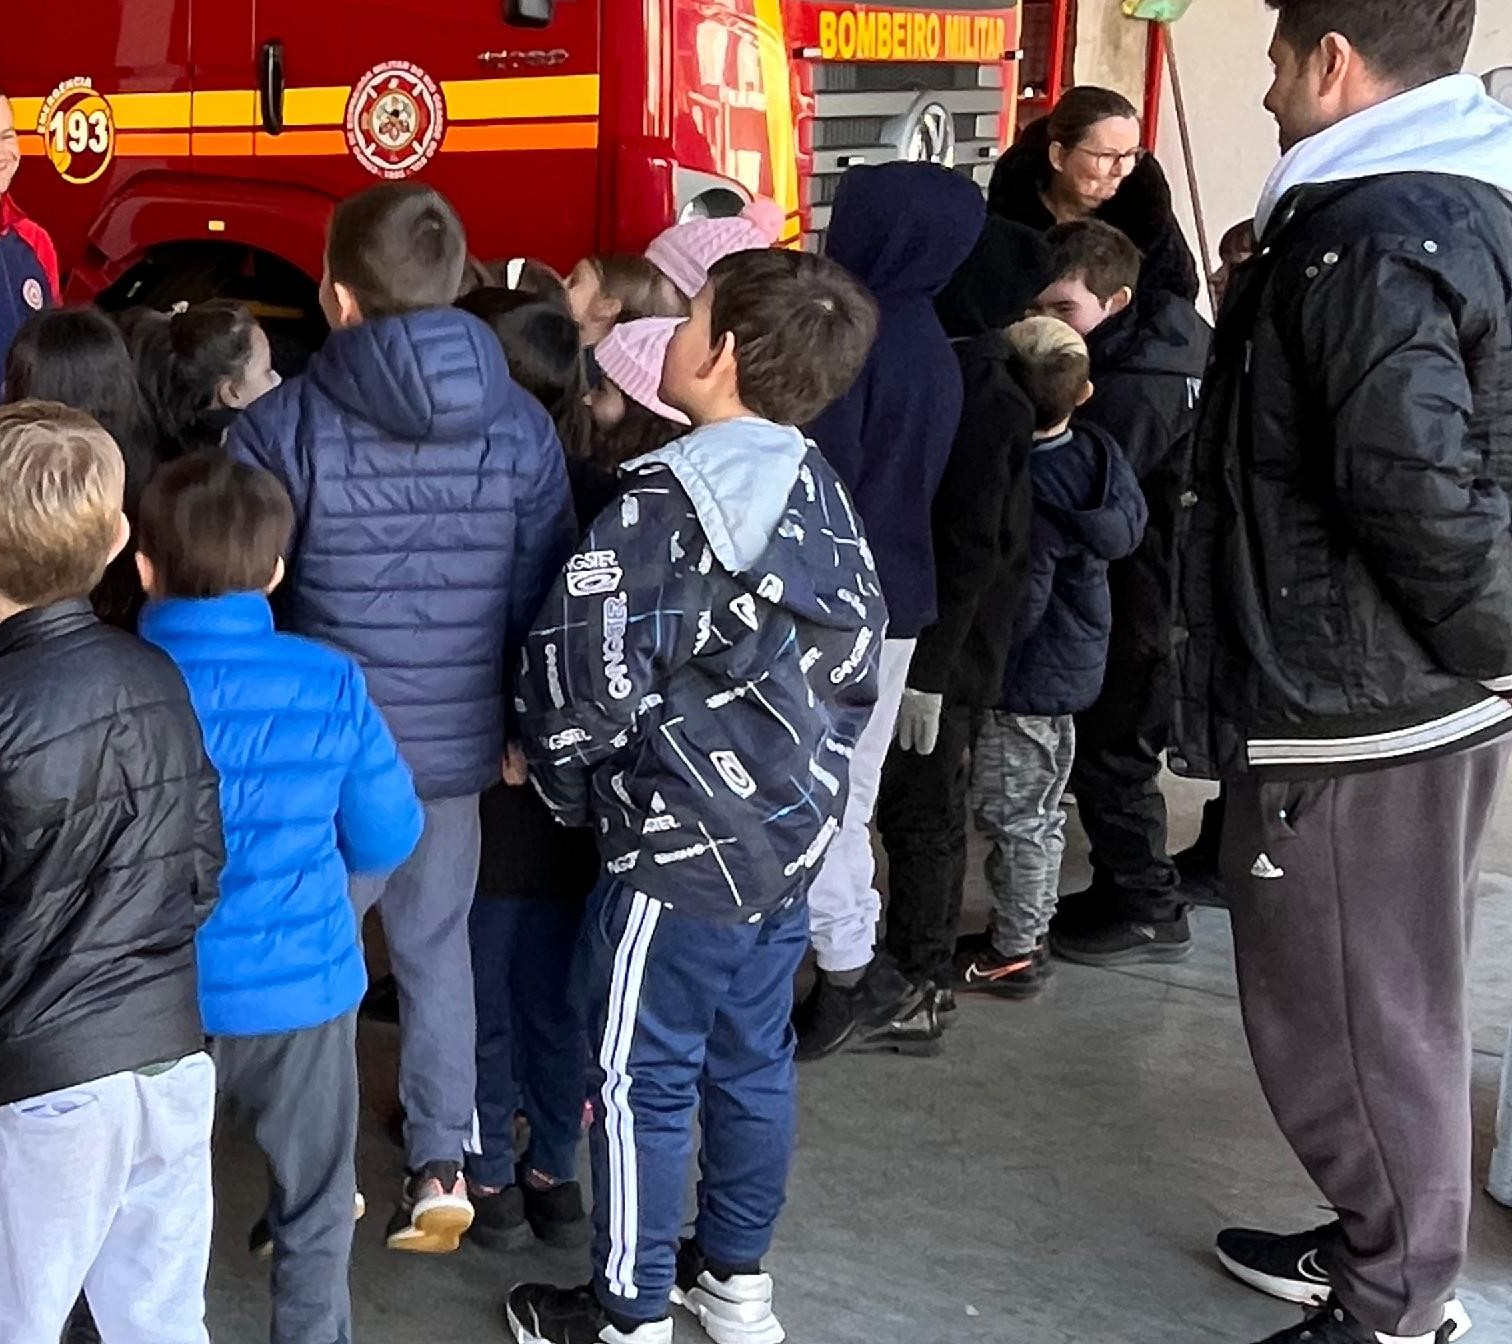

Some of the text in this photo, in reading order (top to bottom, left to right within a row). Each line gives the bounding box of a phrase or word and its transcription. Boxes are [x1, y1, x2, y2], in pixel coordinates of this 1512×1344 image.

[820, 10, 1005, 60] BOMBEIRO MILITAR
[49, 110, 108, 153] 193
